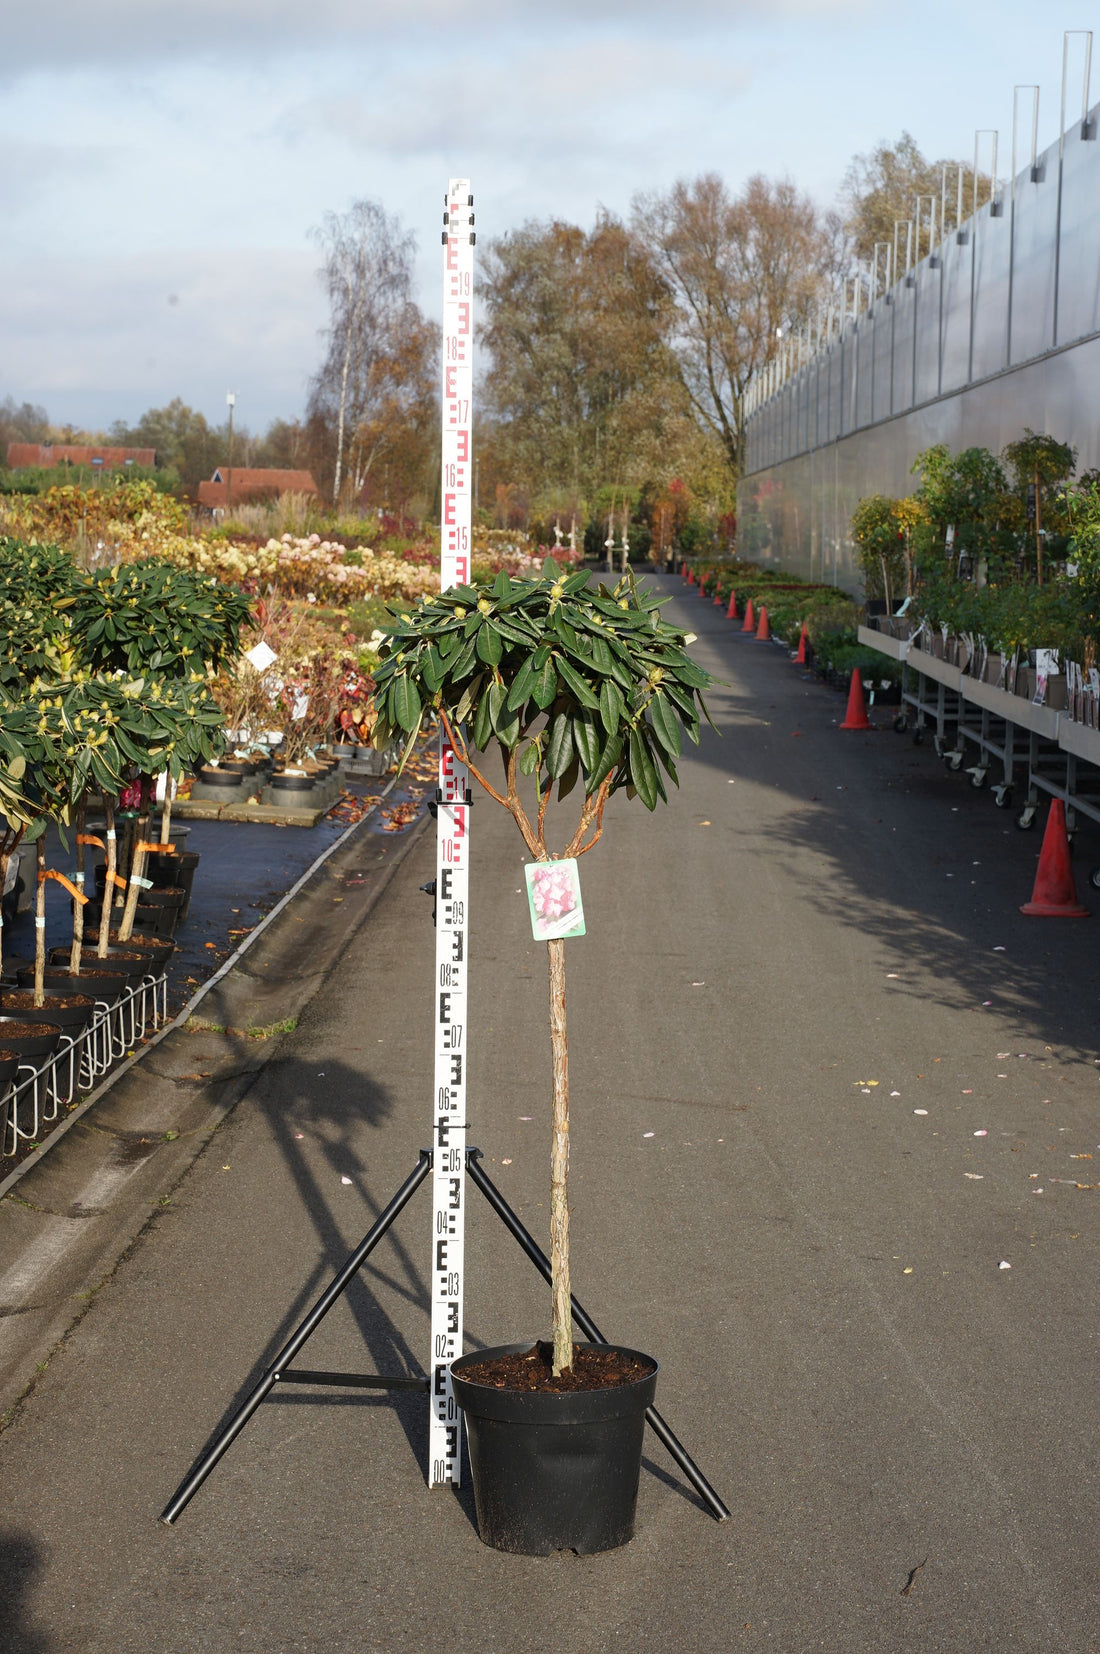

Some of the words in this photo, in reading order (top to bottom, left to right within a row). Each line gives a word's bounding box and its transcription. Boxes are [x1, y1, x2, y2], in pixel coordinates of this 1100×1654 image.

[459, 272, 470, 297] 19
[446, 336, 458, 361] 18
[458, 400, 469, 424] 17
[445, 464, 456, 488] 16
[456, 527, 468, 551] 15
[454, 777, 466, 800] 11
[442, 839, 453, 863] 10
[440, 964, 452, 988] 08
[451, 1025, 463, 1049] 07
[439, 1087, 450, 1111] 06
[450, 1149, 461, 1172] 05
[437, 1211, 448, 1235] 04
[448, 1273, 460, 1297] 03
[436, 1335, 447, 1359] 02
[434, 1460, 445, 1484] 00
